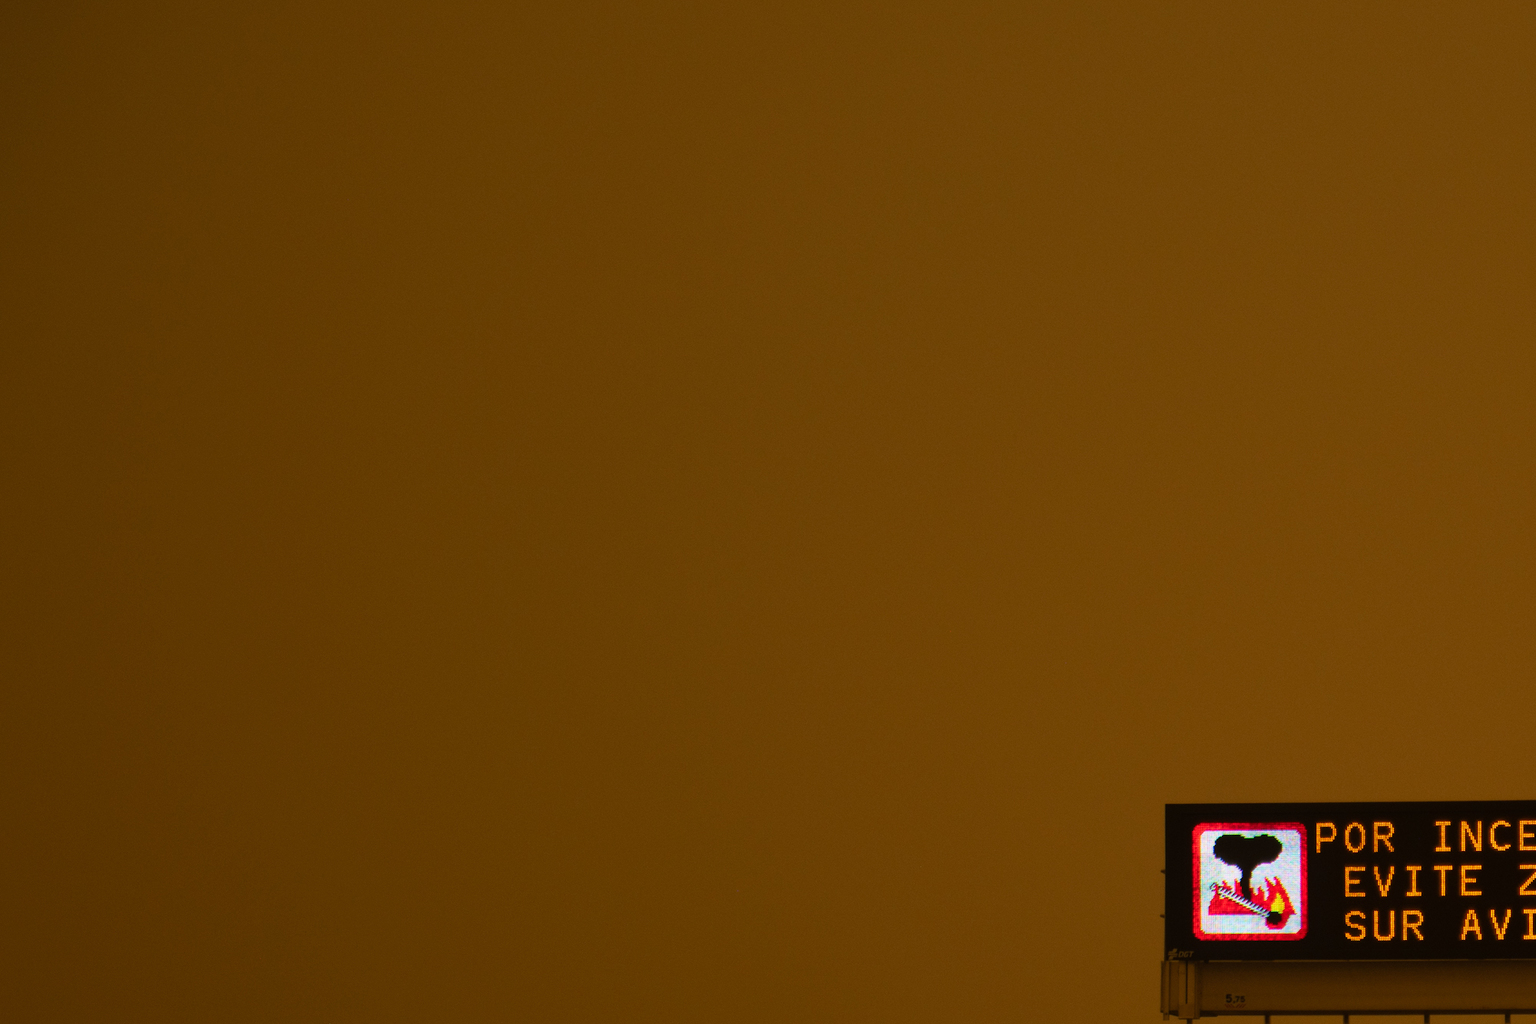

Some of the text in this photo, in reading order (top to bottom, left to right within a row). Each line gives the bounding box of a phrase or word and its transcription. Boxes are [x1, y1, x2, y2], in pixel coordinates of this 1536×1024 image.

[1315, 821, 1395, 854] POR
[1344, 864, 1483, 898] EVITE
[1344, 909, 1425, 942] SUR
[1178, 950, 1194, 958] DGT
